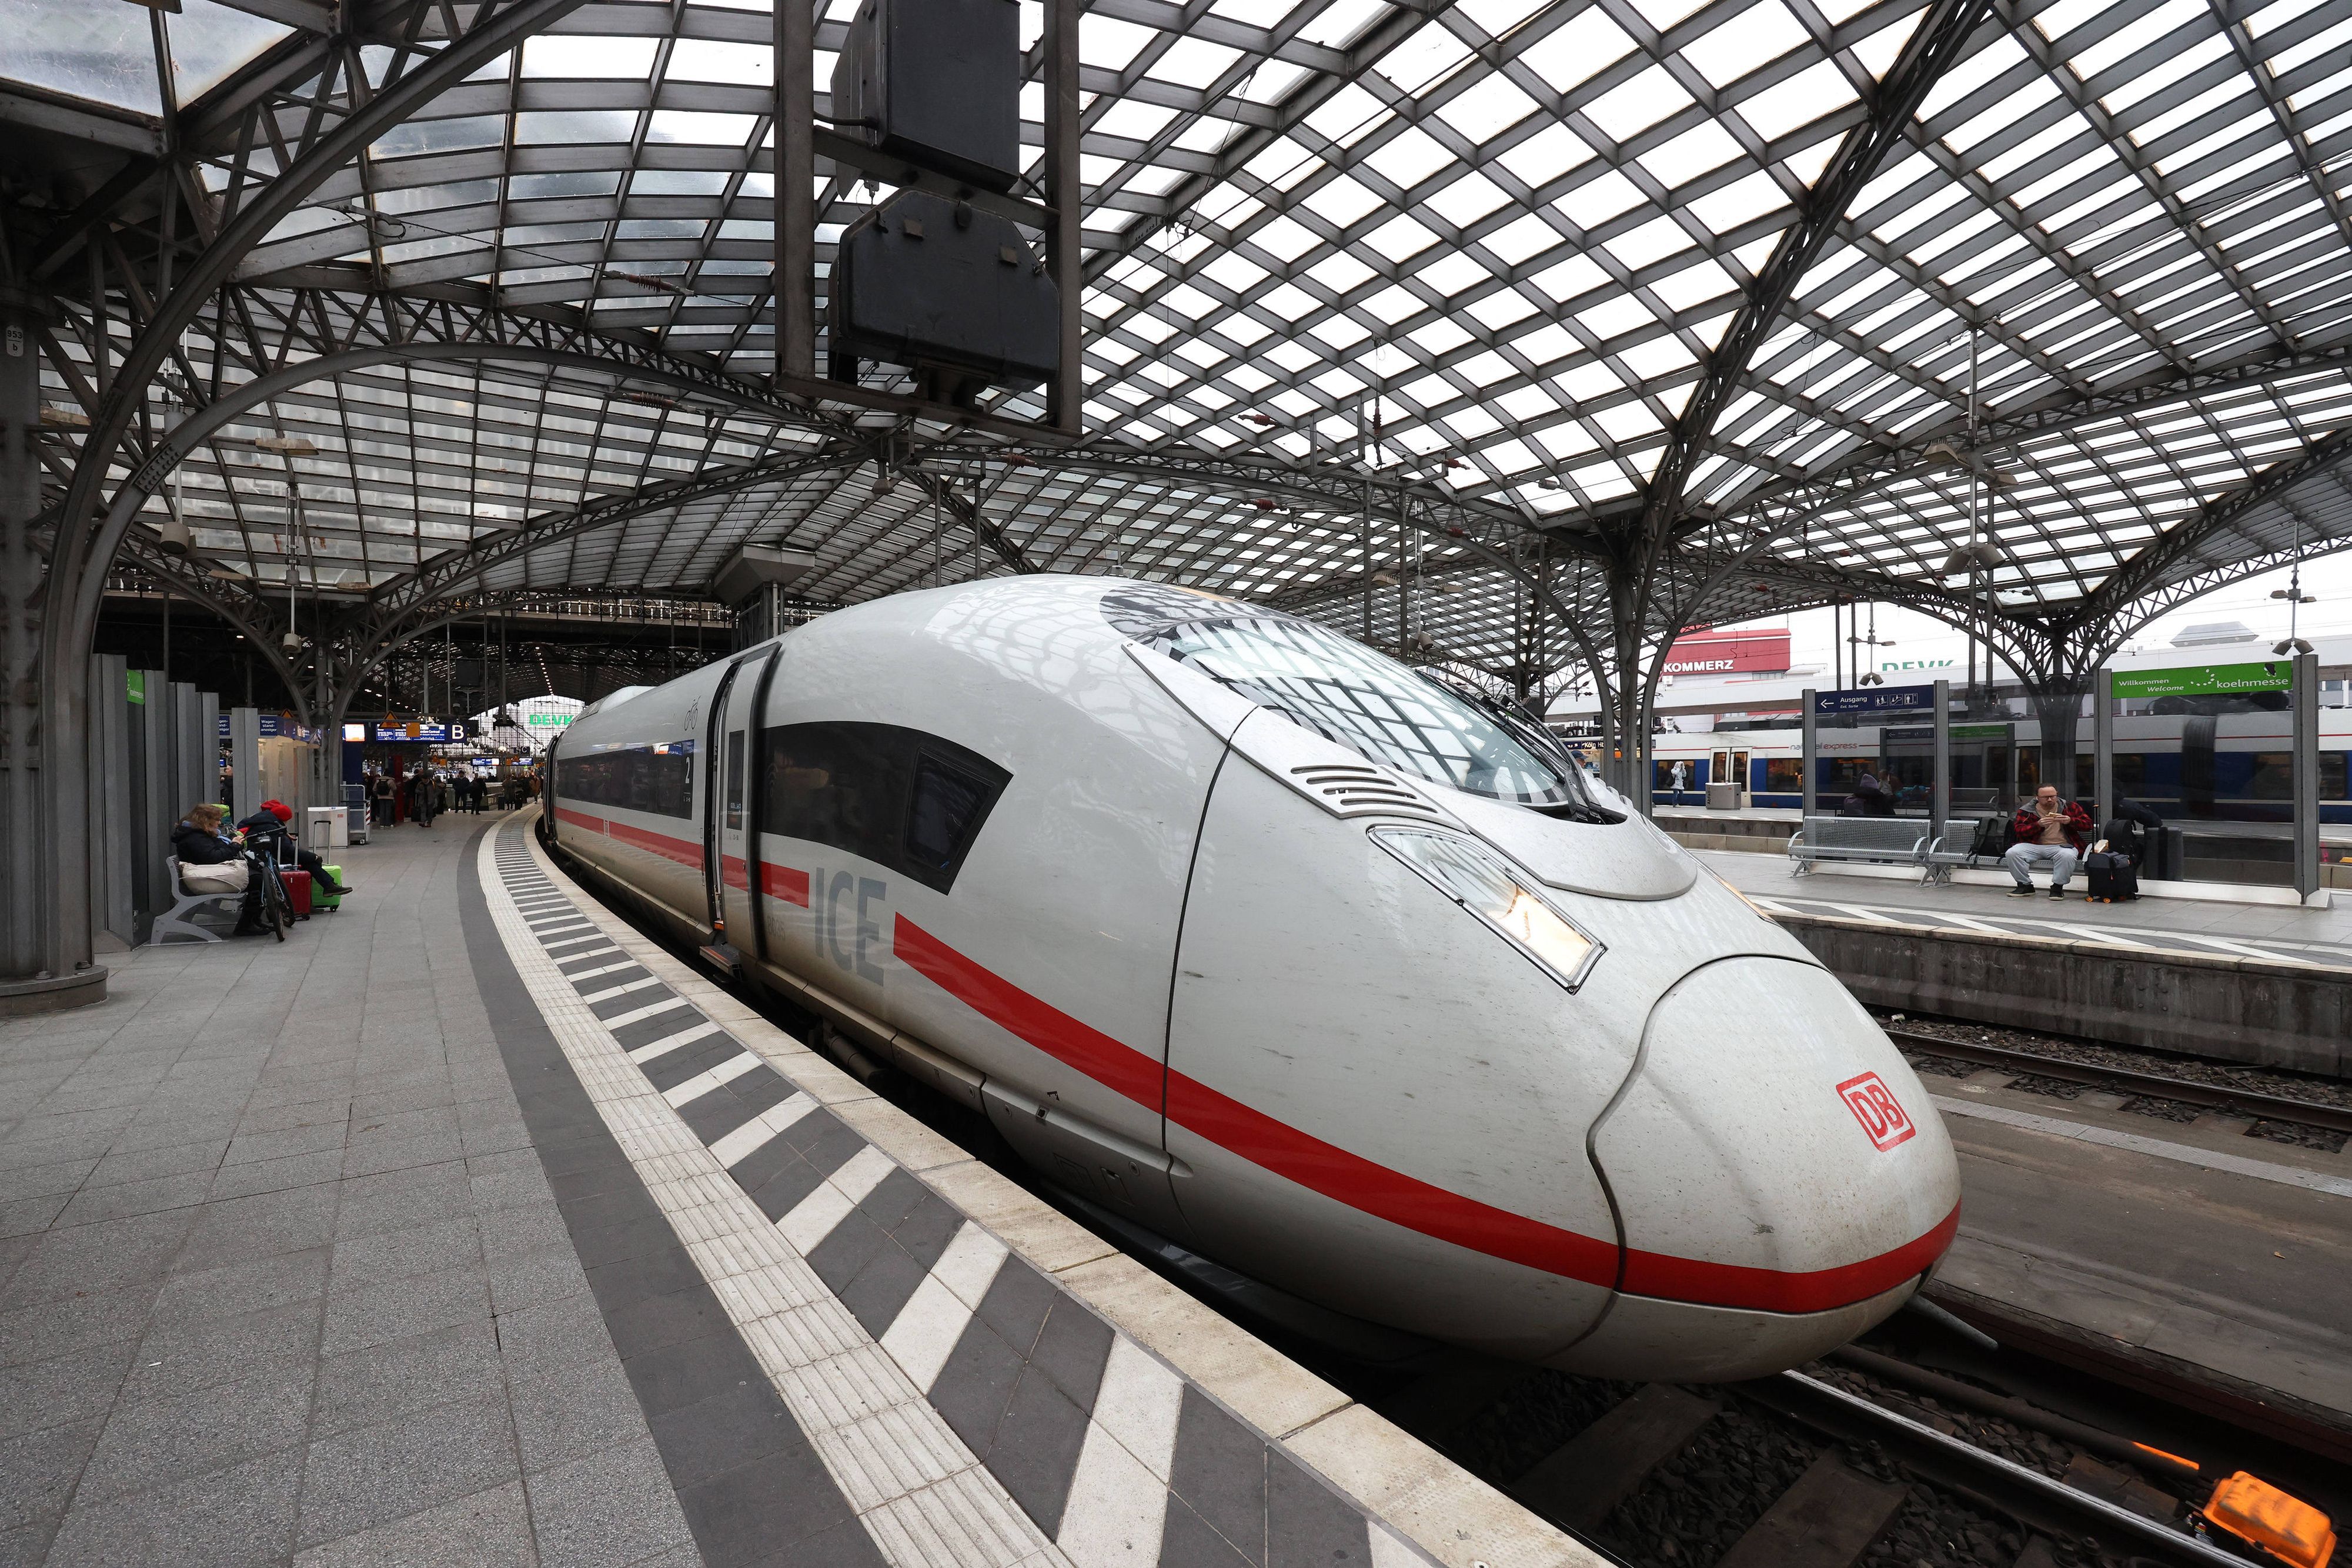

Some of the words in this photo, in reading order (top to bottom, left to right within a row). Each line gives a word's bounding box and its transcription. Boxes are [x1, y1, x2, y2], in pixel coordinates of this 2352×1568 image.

[7, 330, 22, 339] 953
[1663, 660, 1734, 673] KOMMERZ
[2119, 678, 2169, 687] Willkommen
[2147, 684, 2184, 693] Welcome
[2216, 678, 2288, 688] koelnmesse
[530, 714, 574, 726] DEVK
[452, 724, 464, 740] B
[1823, 743, 1857, 751] express
[685, 757, 690, 784] 2
[815, 867, 887, 987] ICE
[1847, 1084, 1905, 1139] DB
